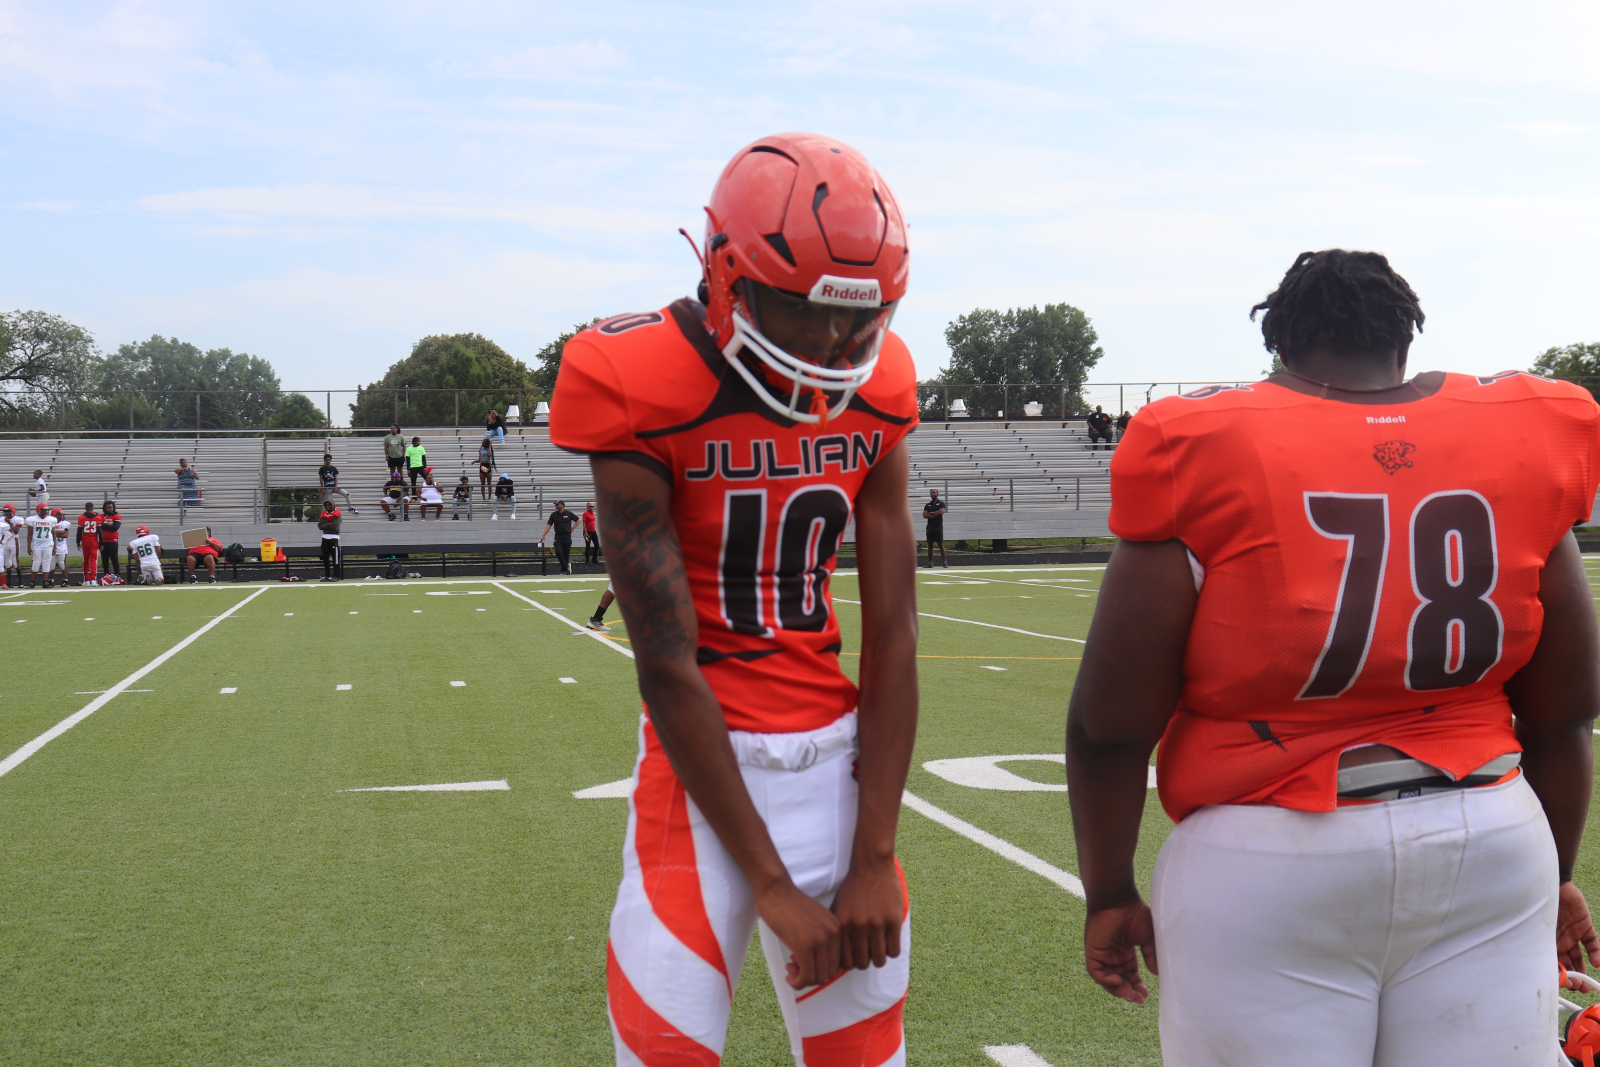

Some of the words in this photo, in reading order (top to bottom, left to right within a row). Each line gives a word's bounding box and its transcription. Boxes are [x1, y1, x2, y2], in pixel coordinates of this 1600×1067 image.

[821, 284, 878, 301] Riddell
[1366, 415, 1406, 424] Riddell
[685, 430, 883, 482] JULIAN
[35, 527, 50, 538] 77
[83, 521, 97, 533] 23
[137, 543, 153, 557] 66
[718, 483, 853, 639] 10
[1294, 489, 1504, 701] 78
